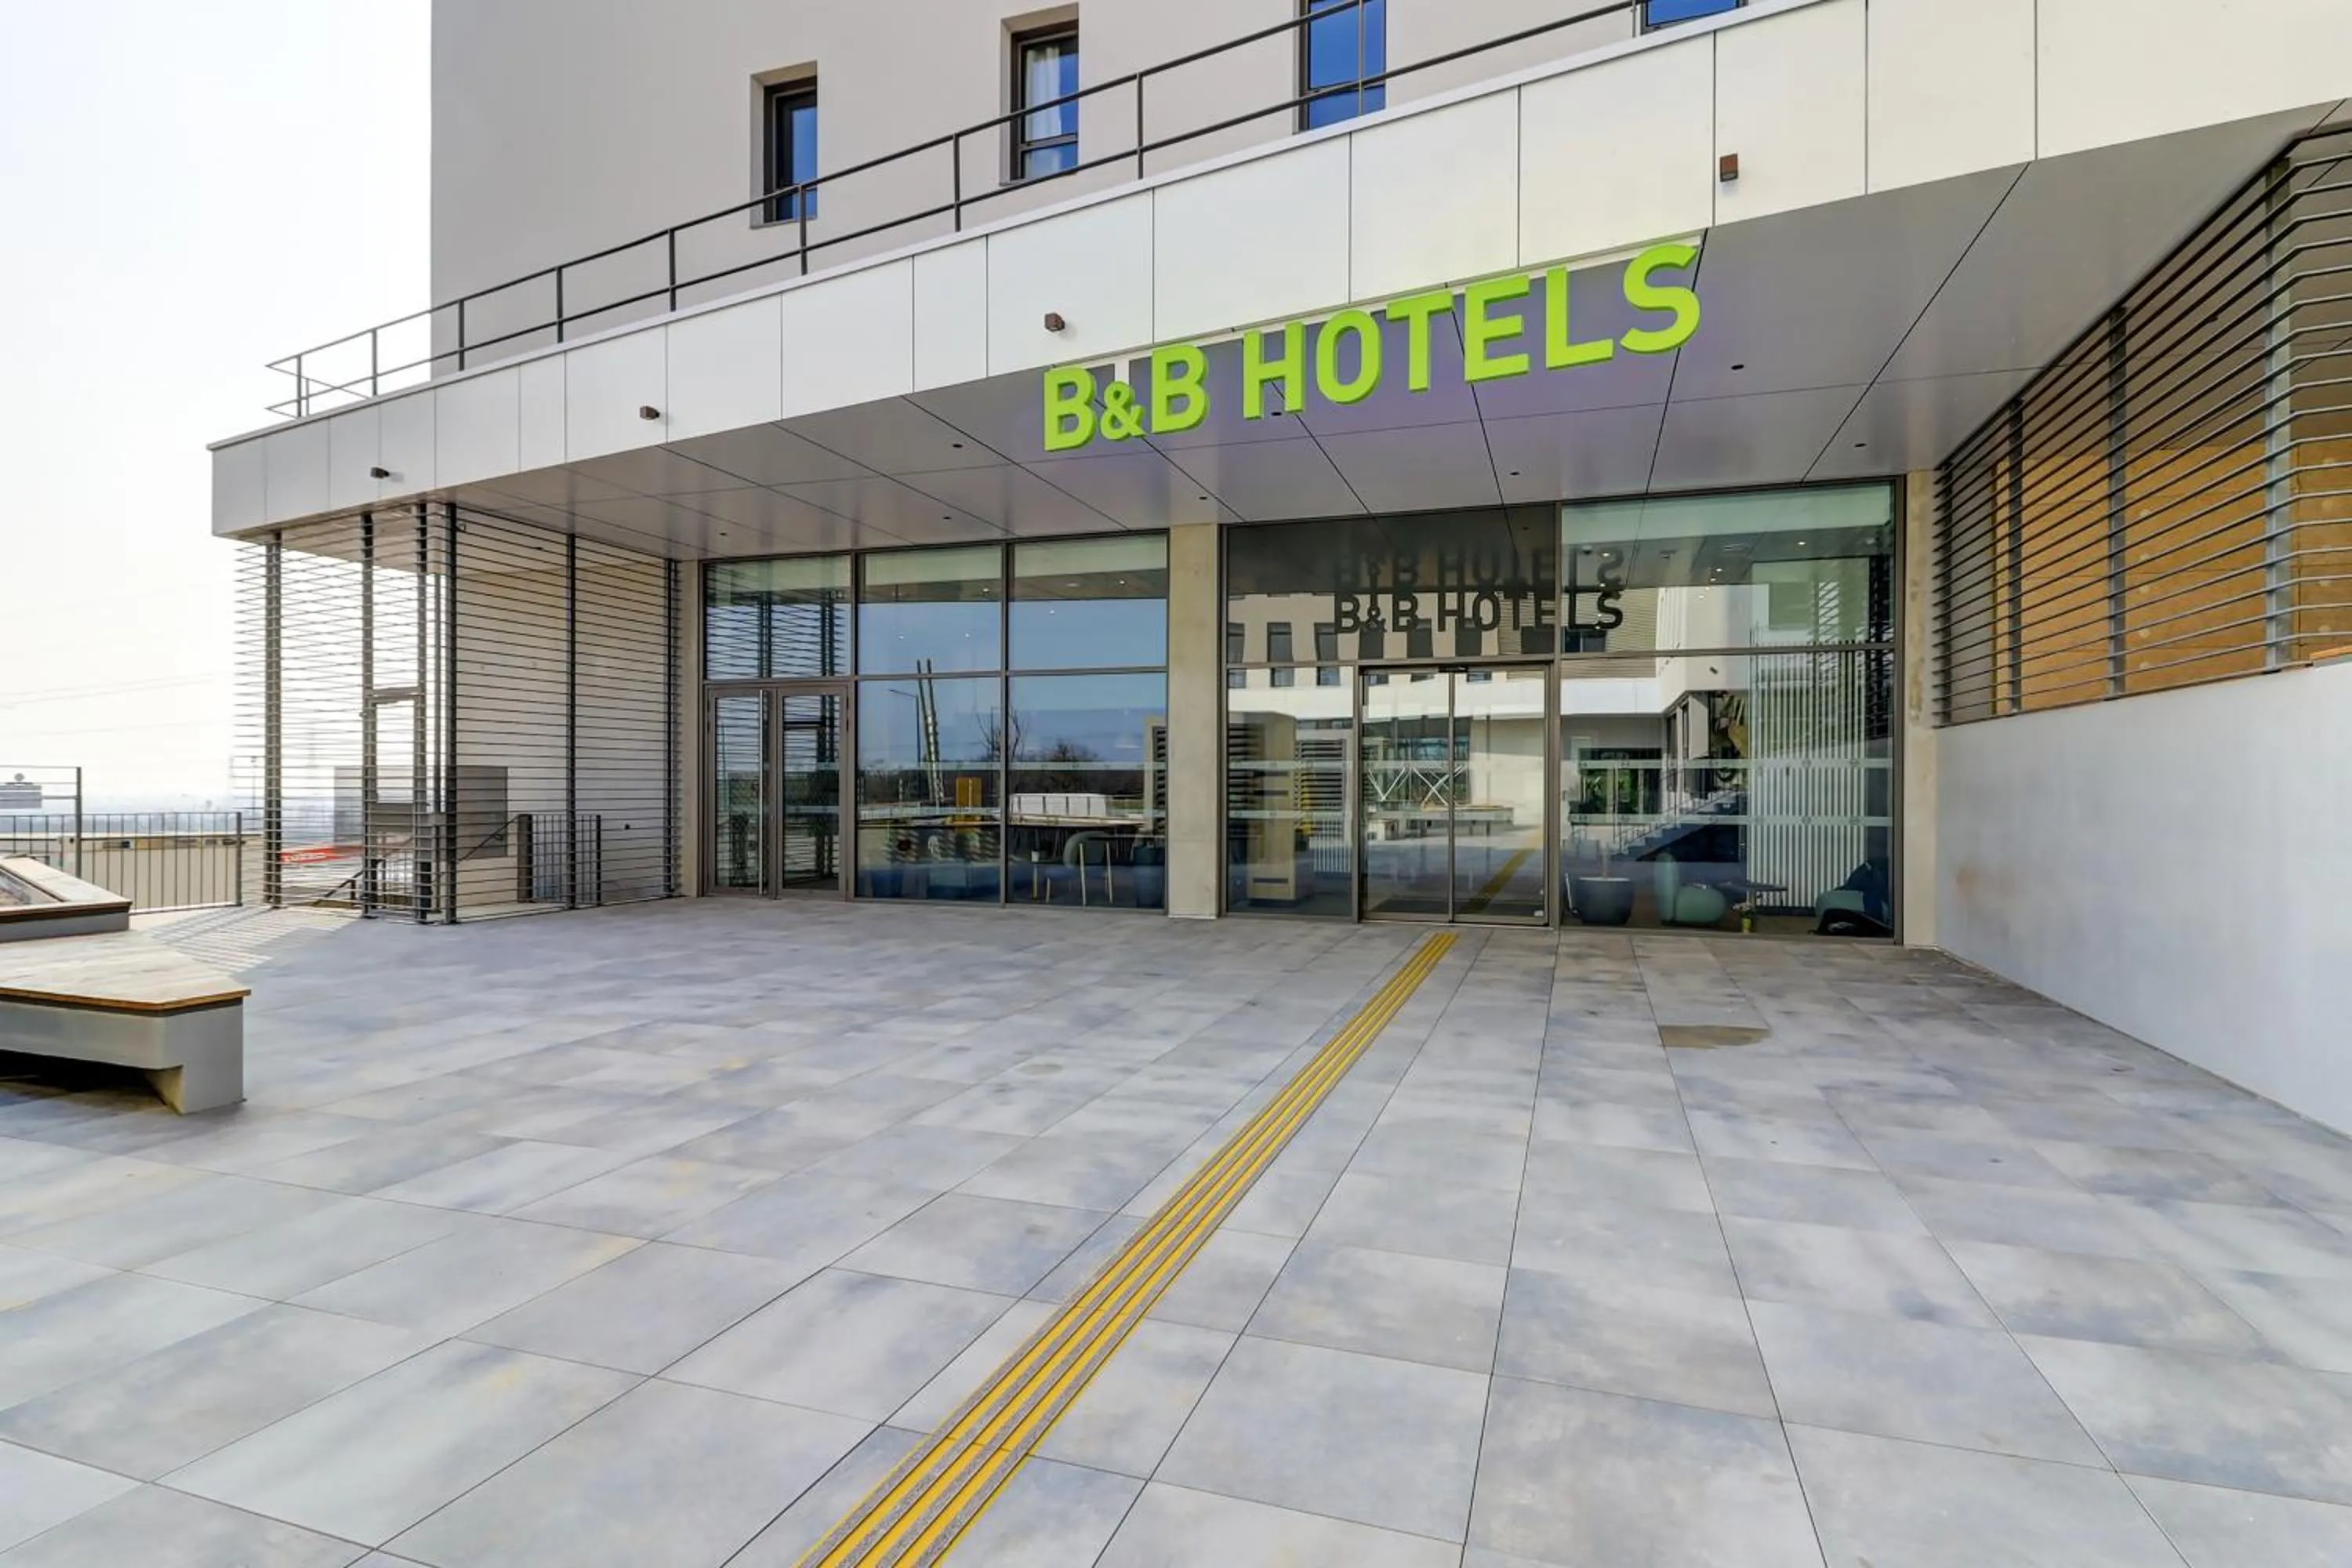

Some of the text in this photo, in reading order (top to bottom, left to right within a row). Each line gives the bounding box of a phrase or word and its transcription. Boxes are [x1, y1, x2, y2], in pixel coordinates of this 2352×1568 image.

[1044, 245, 1702, 452] B&B HOTELS
[1334, 590, 1624, 633] B&B HOTELS
